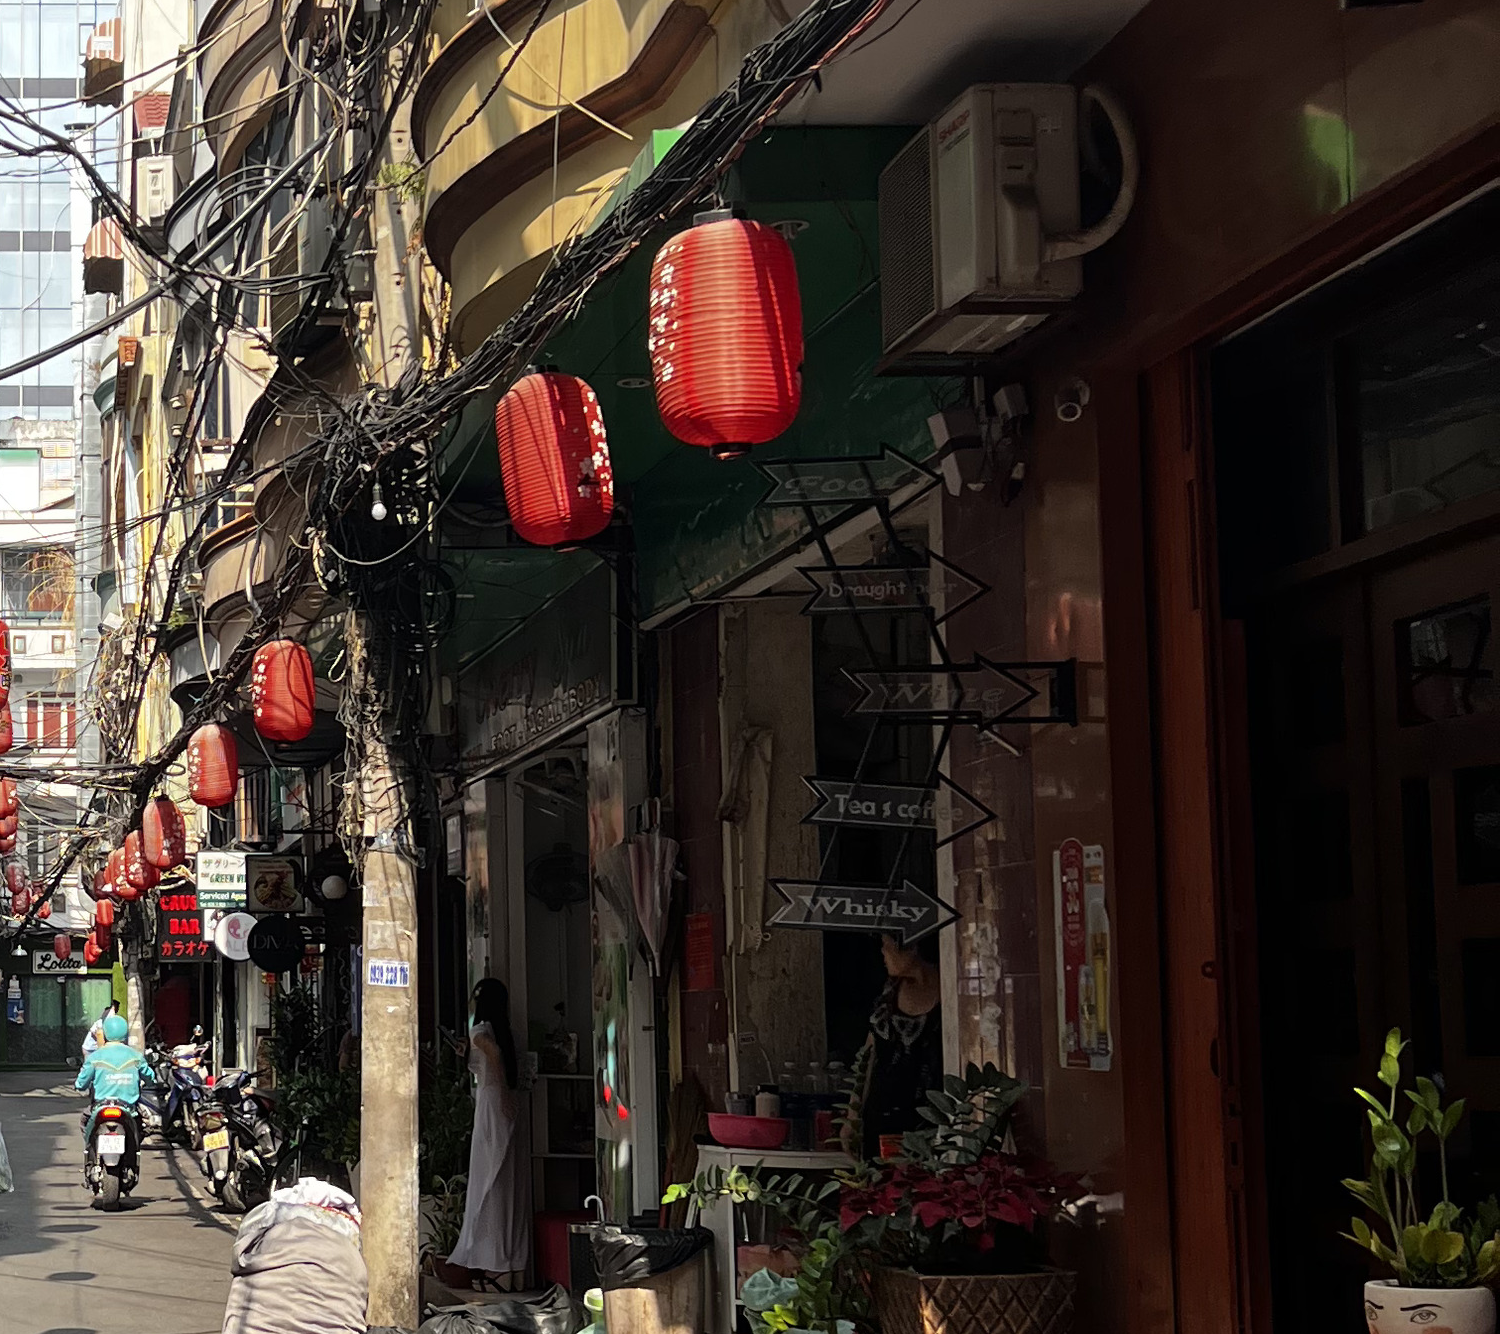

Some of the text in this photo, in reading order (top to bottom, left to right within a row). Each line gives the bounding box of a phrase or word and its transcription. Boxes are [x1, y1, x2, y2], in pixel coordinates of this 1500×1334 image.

[834, 794, 876, 816] Tea
[797, 894, 931, 923] Whisky
[169, 918, 201, 935] BAR
[161, 940, 209, 957] カラオケ
[37, 953, 84, 971] Lolita
